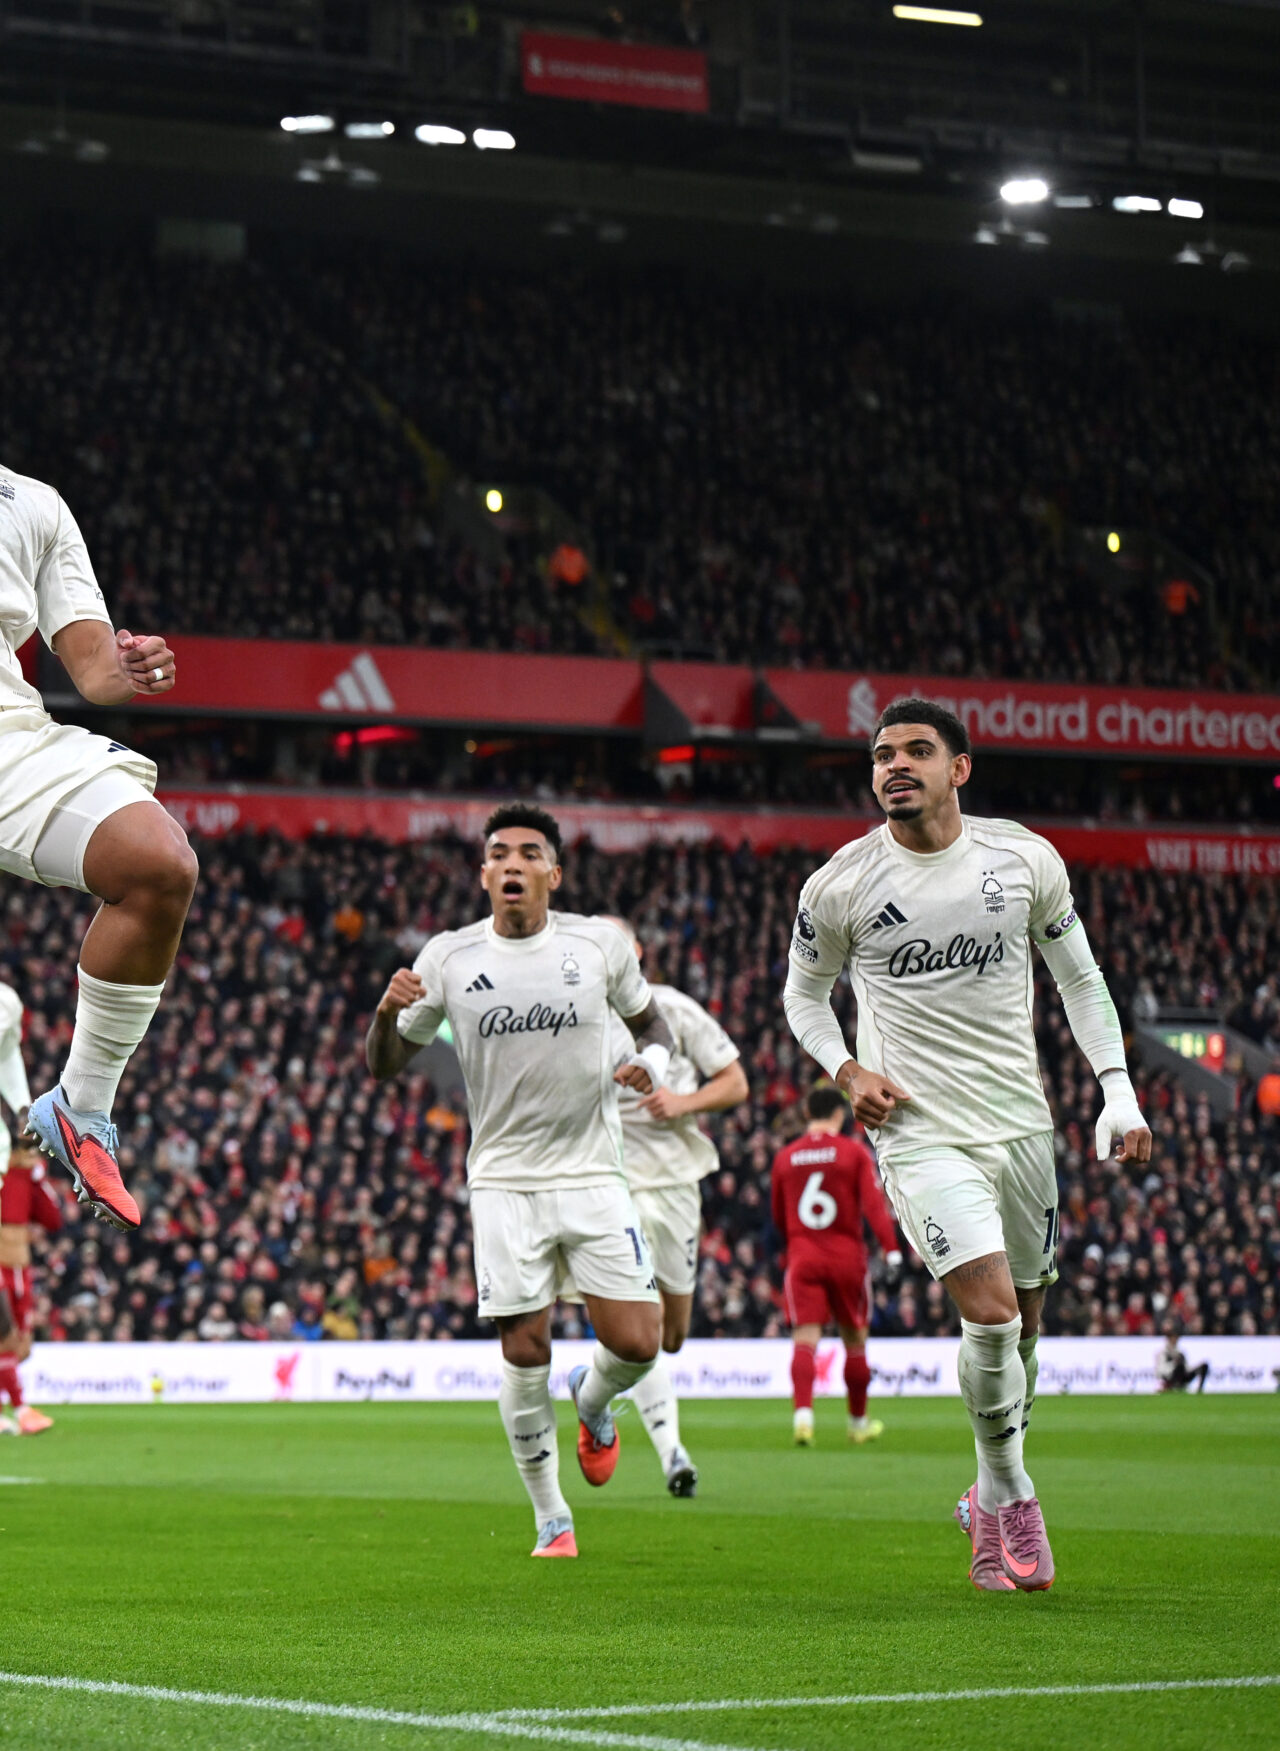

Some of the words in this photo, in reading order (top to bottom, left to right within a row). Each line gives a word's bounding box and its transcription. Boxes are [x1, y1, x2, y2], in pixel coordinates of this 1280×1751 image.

[888, 931, 1004, 978] Bally's
[479, 1001, 579, 1039] Bally's
[797, 1171, 838, 1231] 6
[335, 1370, 413, 1401] PayPal
